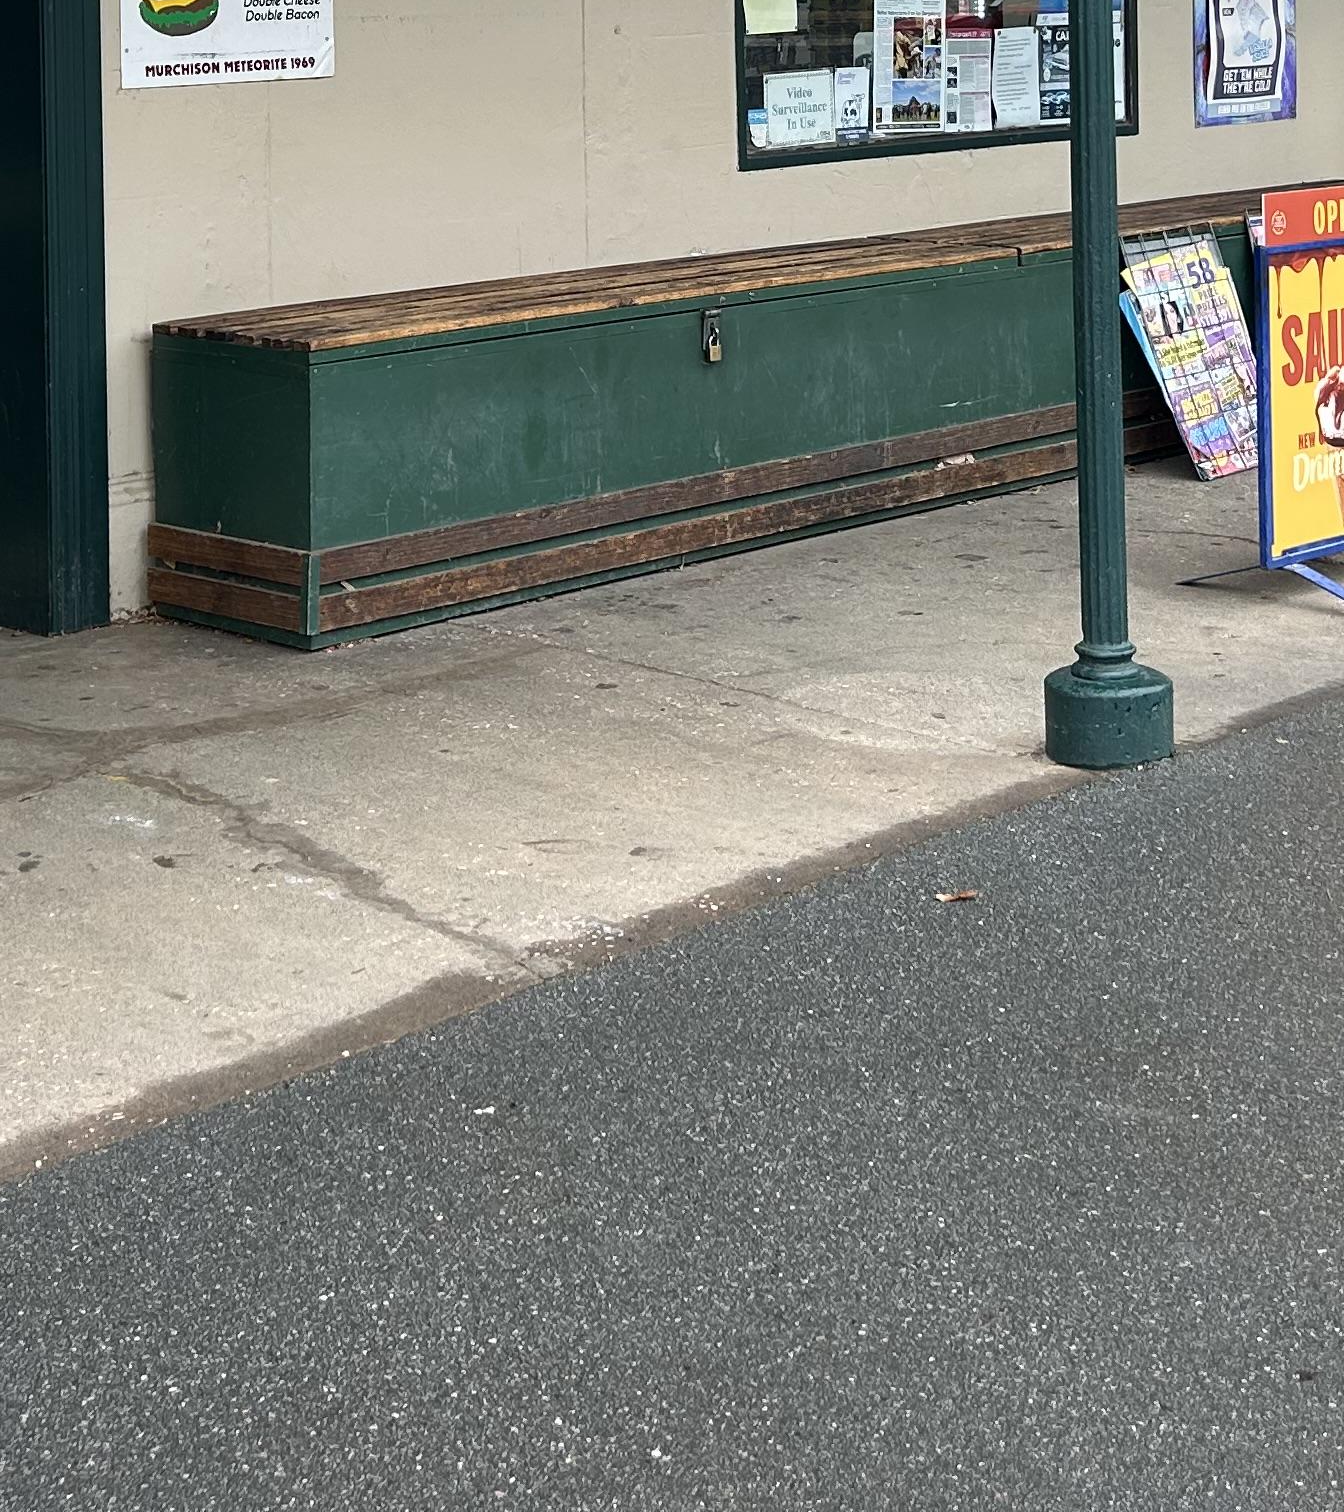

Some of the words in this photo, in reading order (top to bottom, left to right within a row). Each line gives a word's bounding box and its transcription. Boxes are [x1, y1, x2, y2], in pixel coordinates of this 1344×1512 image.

[245, 9, 283, 22] Double
[285, 8, 320, 21] Bacon
[145, 62, 220, 77] MURCHISON
[224, 59, 287, 74] METEORITE
[290, 57, 316, 71] 1969
[786, 87, 813, 100] Video
[771, 101, 828, 117] Surveillance
[799, 117, 817, 129] Use
[1185, 257, 1216, 289] 58
[1298, 434, 1316, 451] NEW
